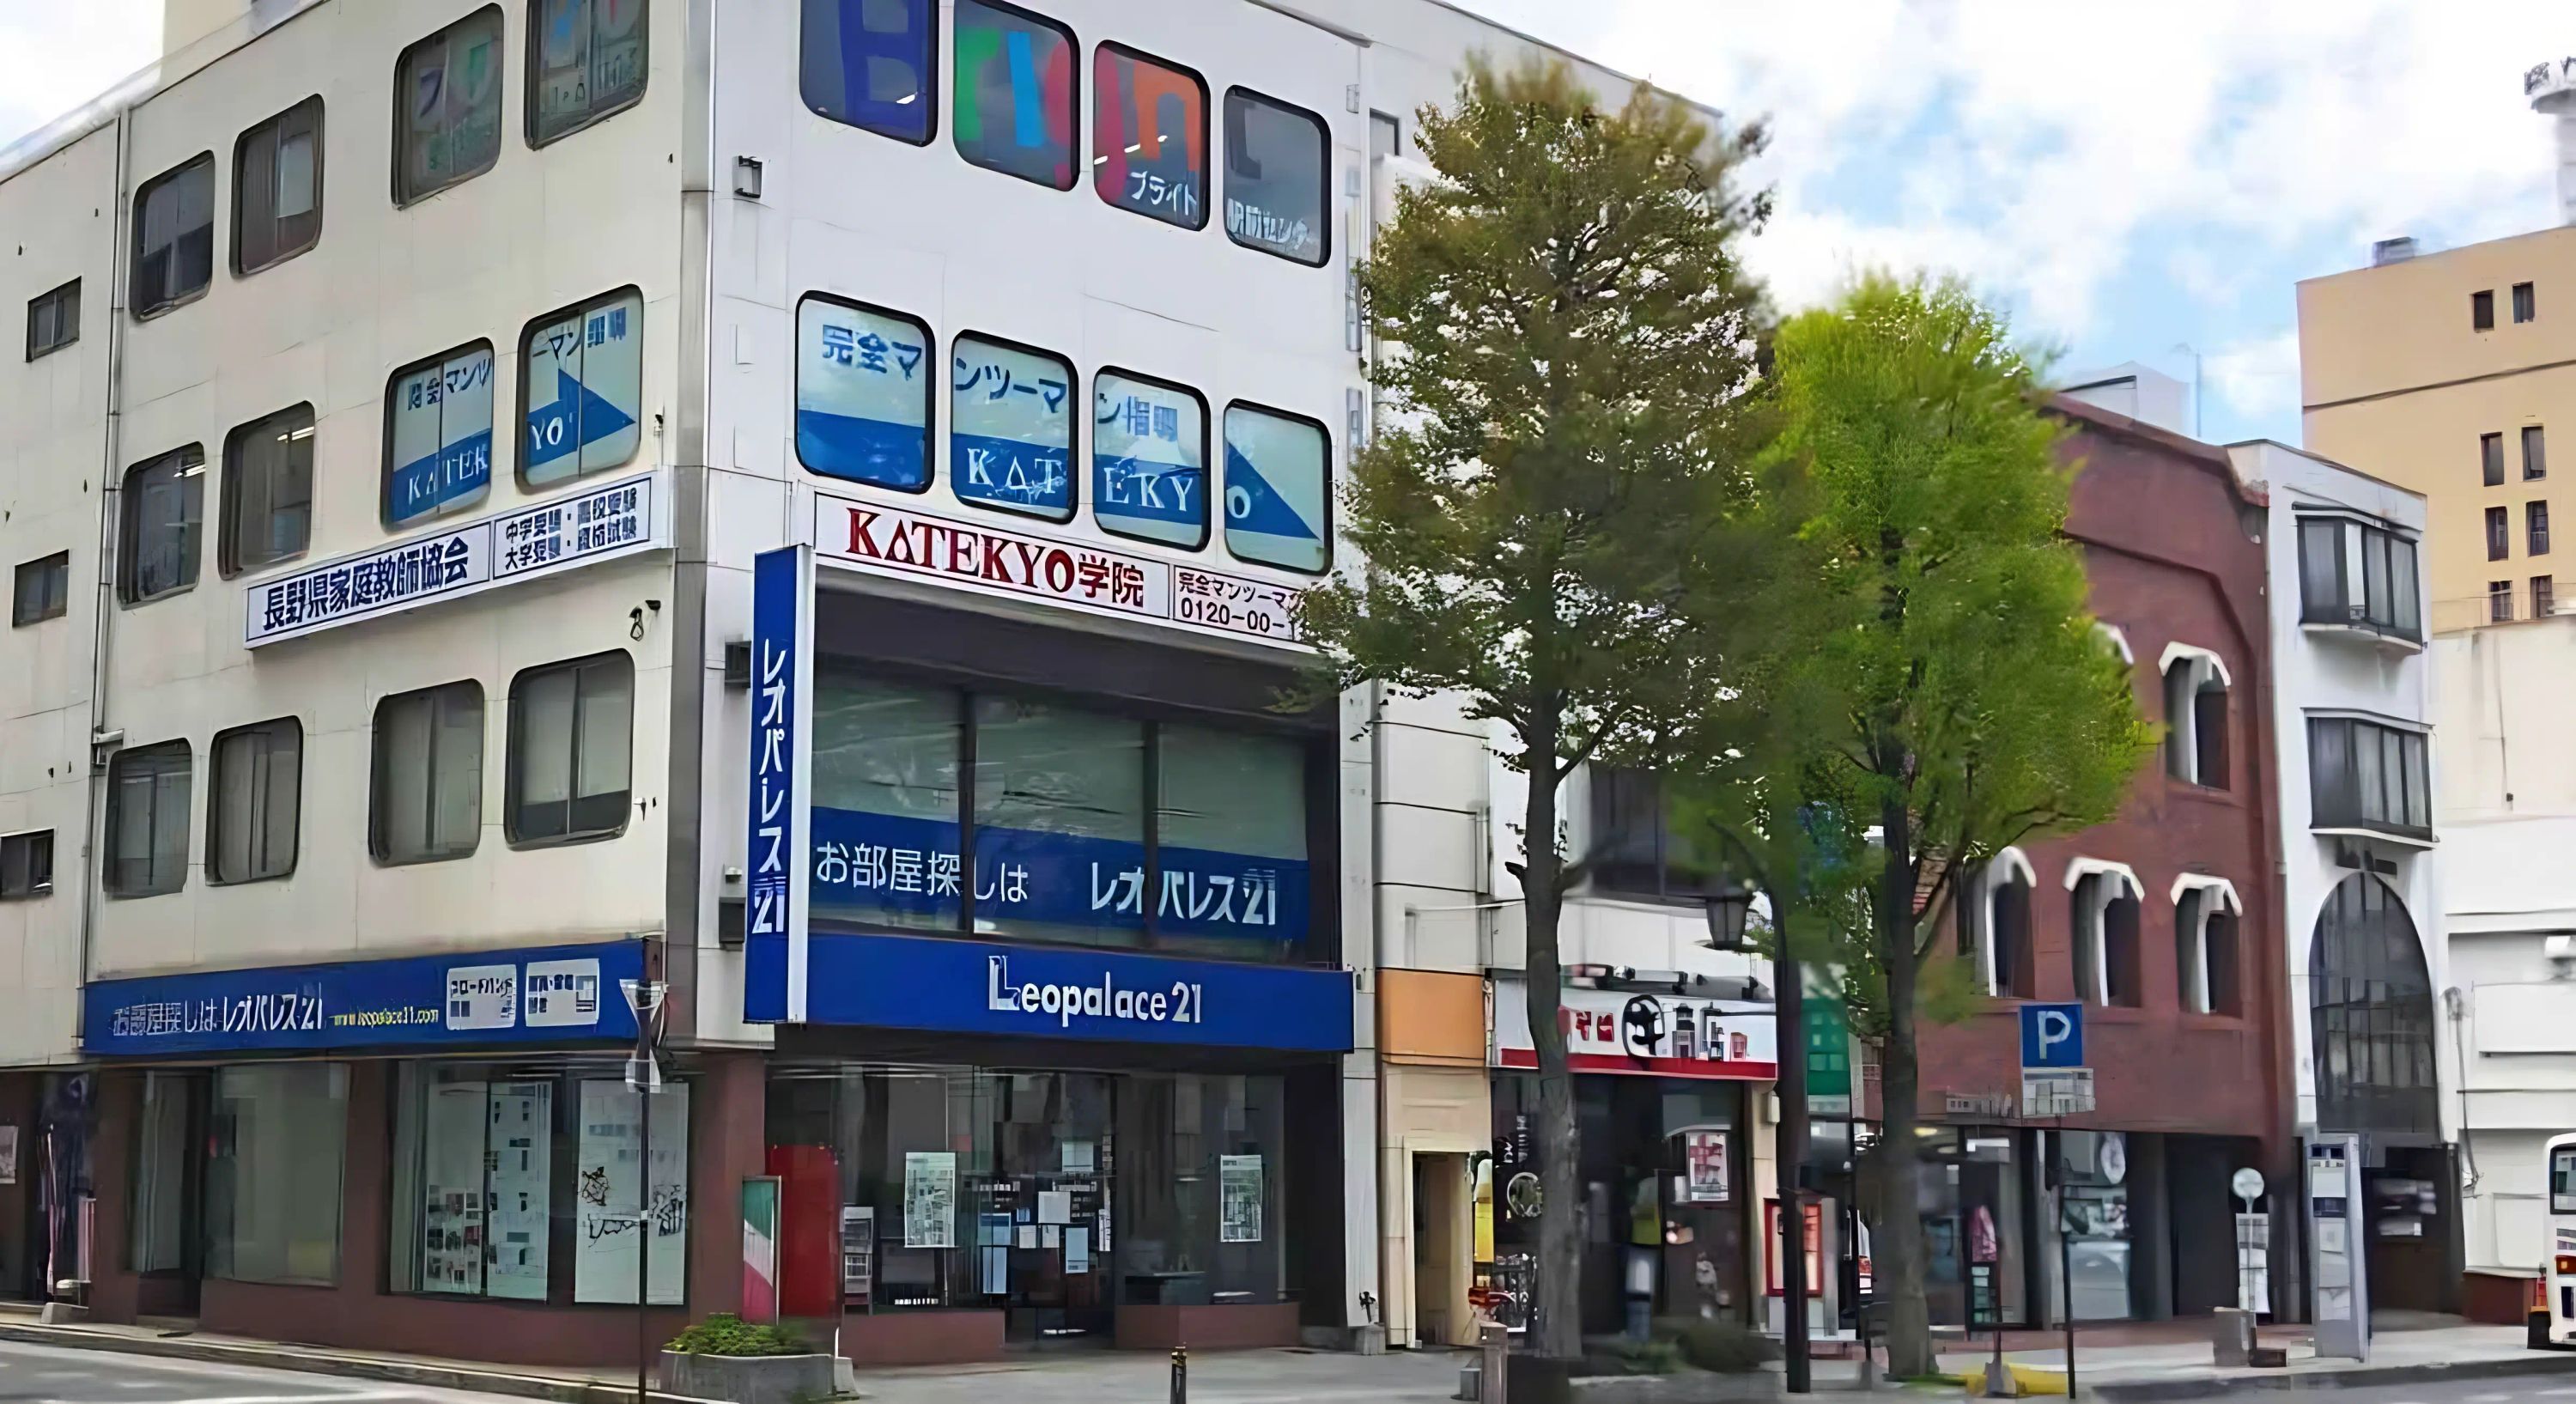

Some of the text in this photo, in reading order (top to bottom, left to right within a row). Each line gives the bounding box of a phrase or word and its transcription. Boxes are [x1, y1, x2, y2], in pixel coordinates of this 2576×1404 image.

[262, 537, 469, 631] 長野県家庭教師協会
[751, 639, 787, 934] レオパレス21
[817, 841, 1029, 903] お部屋探しは
[988, 955, 1201, 1027] Leopalace 21
[2037, 1010, 2072, 1060] P
